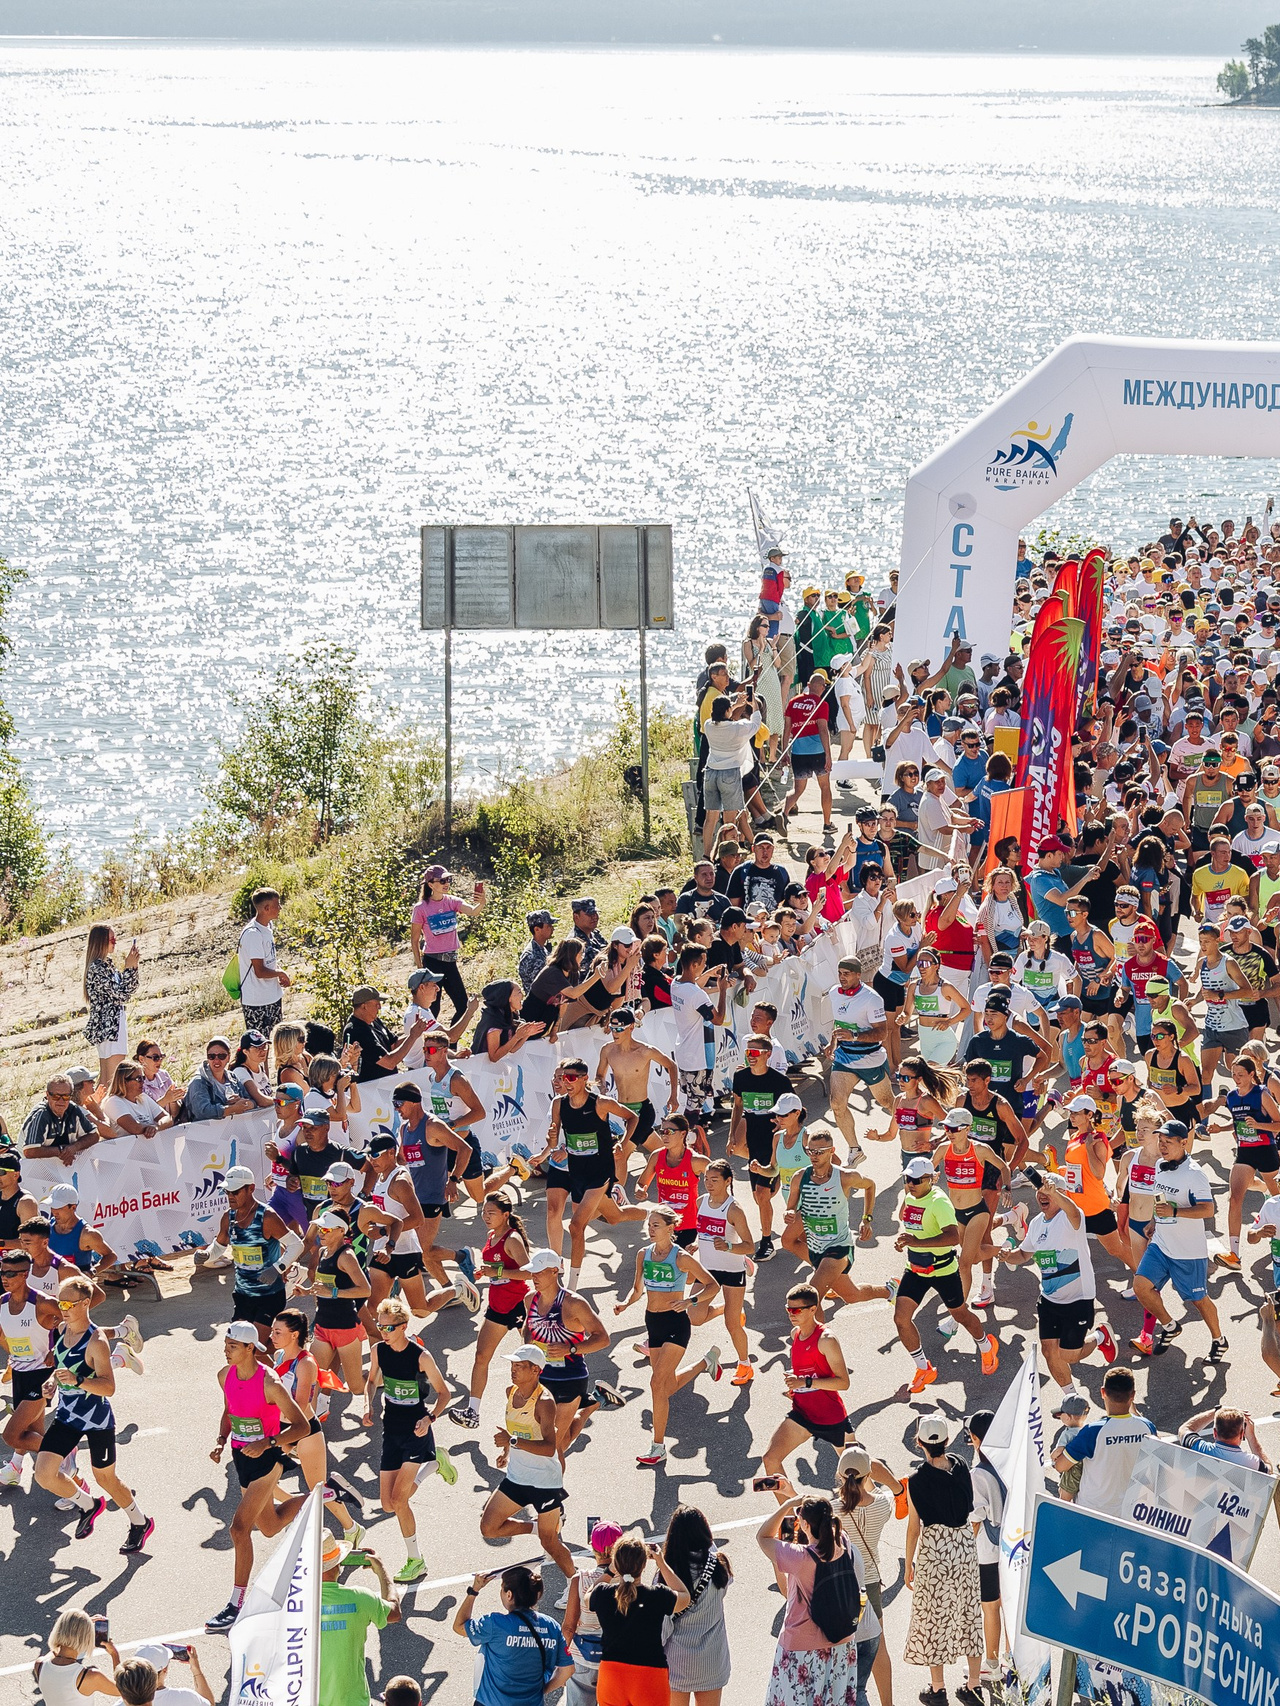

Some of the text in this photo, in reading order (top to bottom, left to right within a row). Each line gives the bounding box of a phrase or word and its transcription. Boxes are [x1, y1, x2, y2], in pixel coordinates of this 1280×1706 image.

[986, 466, 1050, 480] PURE BAIKAL
[985, 477, 1050, 486] MARATHON
[943, 523, 974, 664] СТА
[492, 1118, 524, 1131] PURE BAIKAL
[957, 1165, 975, 1173] 333
[660, 1176, 689, 1188] MONGOLIA
[1156, 1183, 1184, 1195] ПОСТЕР
[93, 1190, 181, 1221] Альфа Банк
[191, 1196, 228, 1212] PURE BAIKA
[191, 1206, 227, 1218] MARATHO
[706, 1225, 725, 1233] 430
[652, 1270, 673, 1280] 714
[1217, 1492, 1240, 1517] 42
[1132, 1502, 1192, 1537] ФИНИШ
[1118, 1550, 1263, 1650] база отдыха
[506, 1633, 558, 1651] ОРГАНИАТОР
